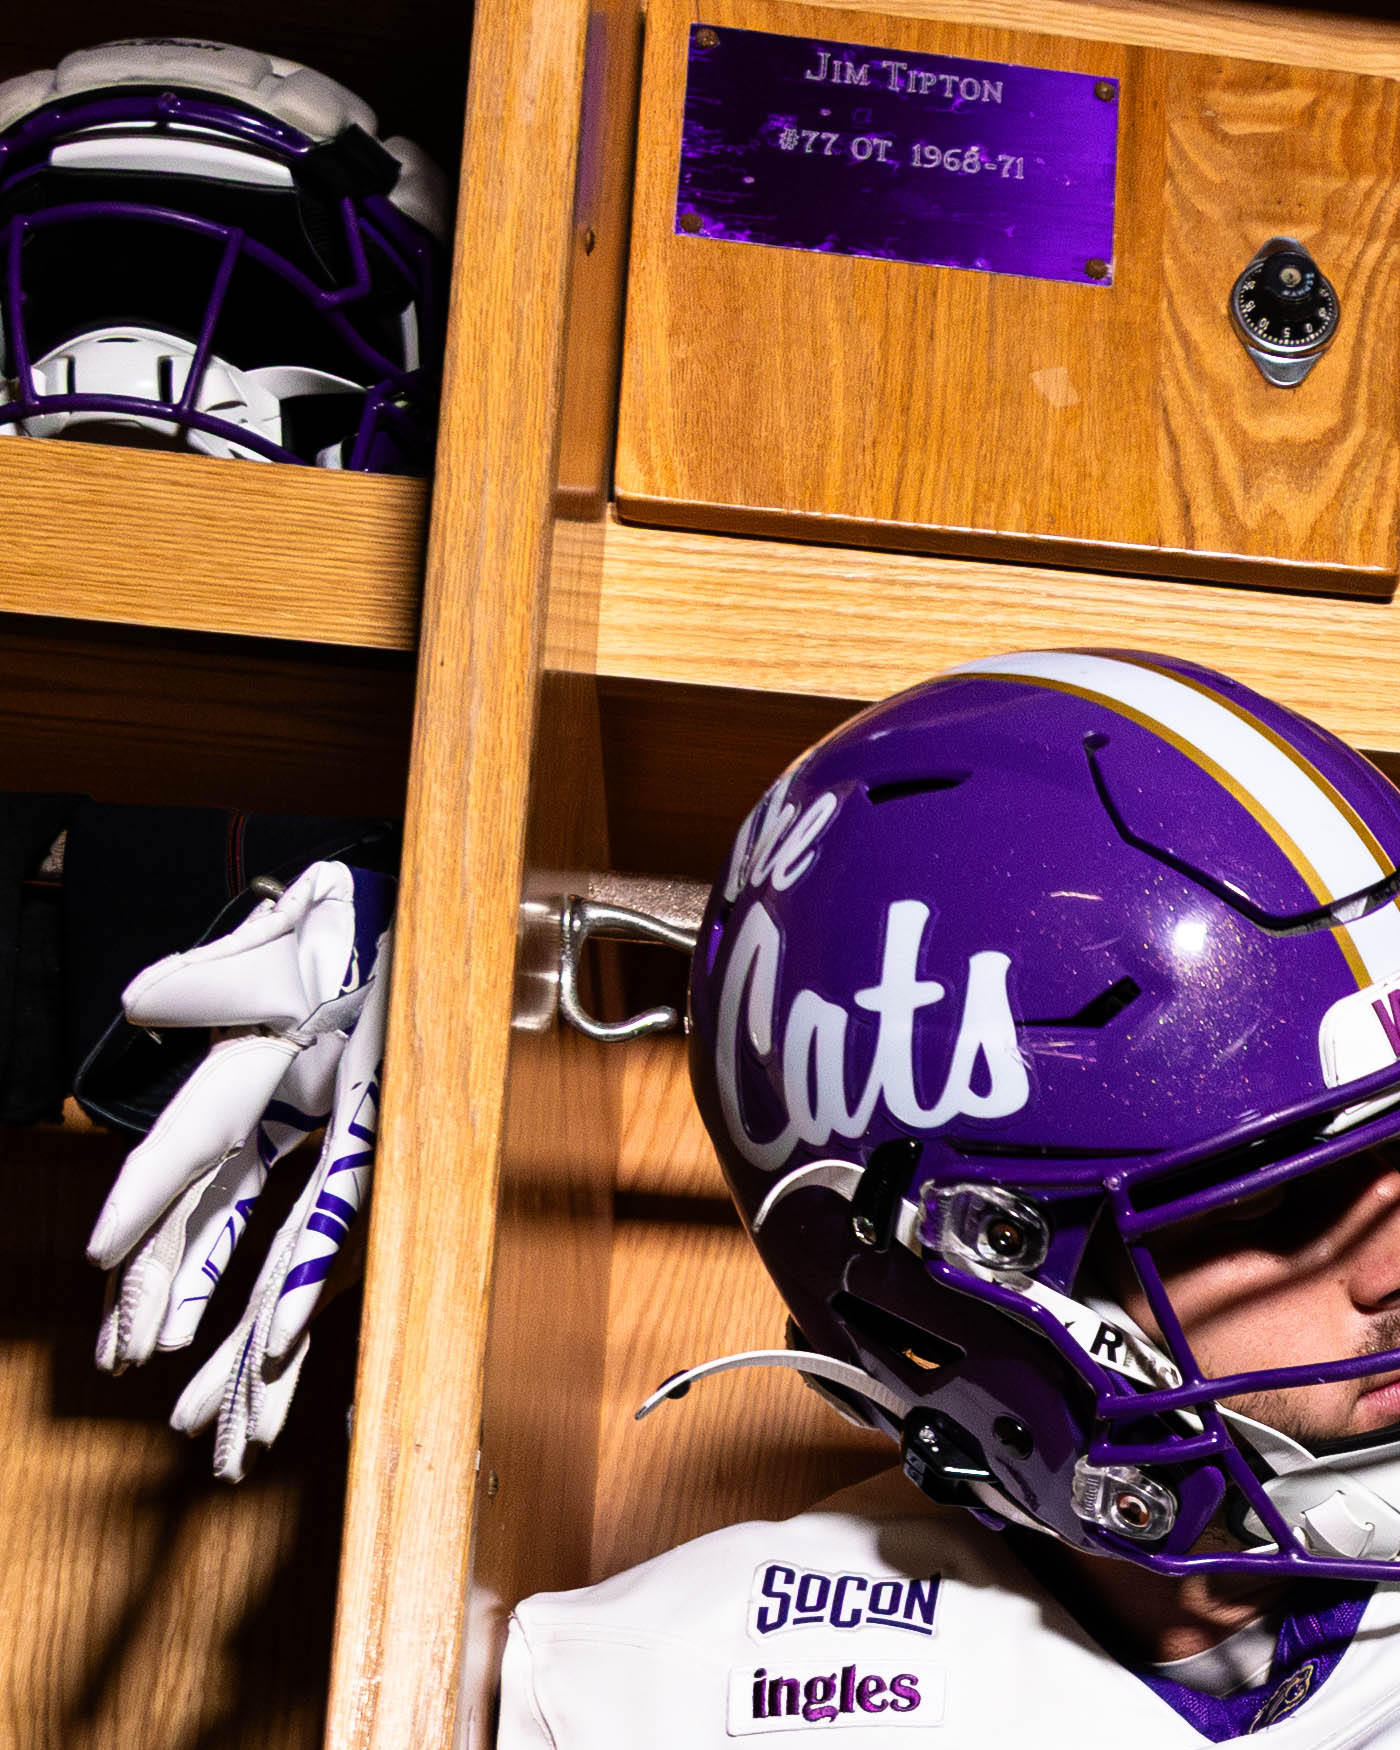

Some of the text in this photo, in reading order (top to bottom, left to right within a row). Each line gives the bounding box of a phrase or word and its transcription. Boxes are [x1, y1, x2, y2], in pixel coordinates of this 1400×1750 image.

[882, 60, 1004, 104] TIPTON
[779, 126, 1025, 180] #77 OT 1968-71
[716, 899, 1030, 1171] Cats
[752, 1663, 922, 1723] ingles
